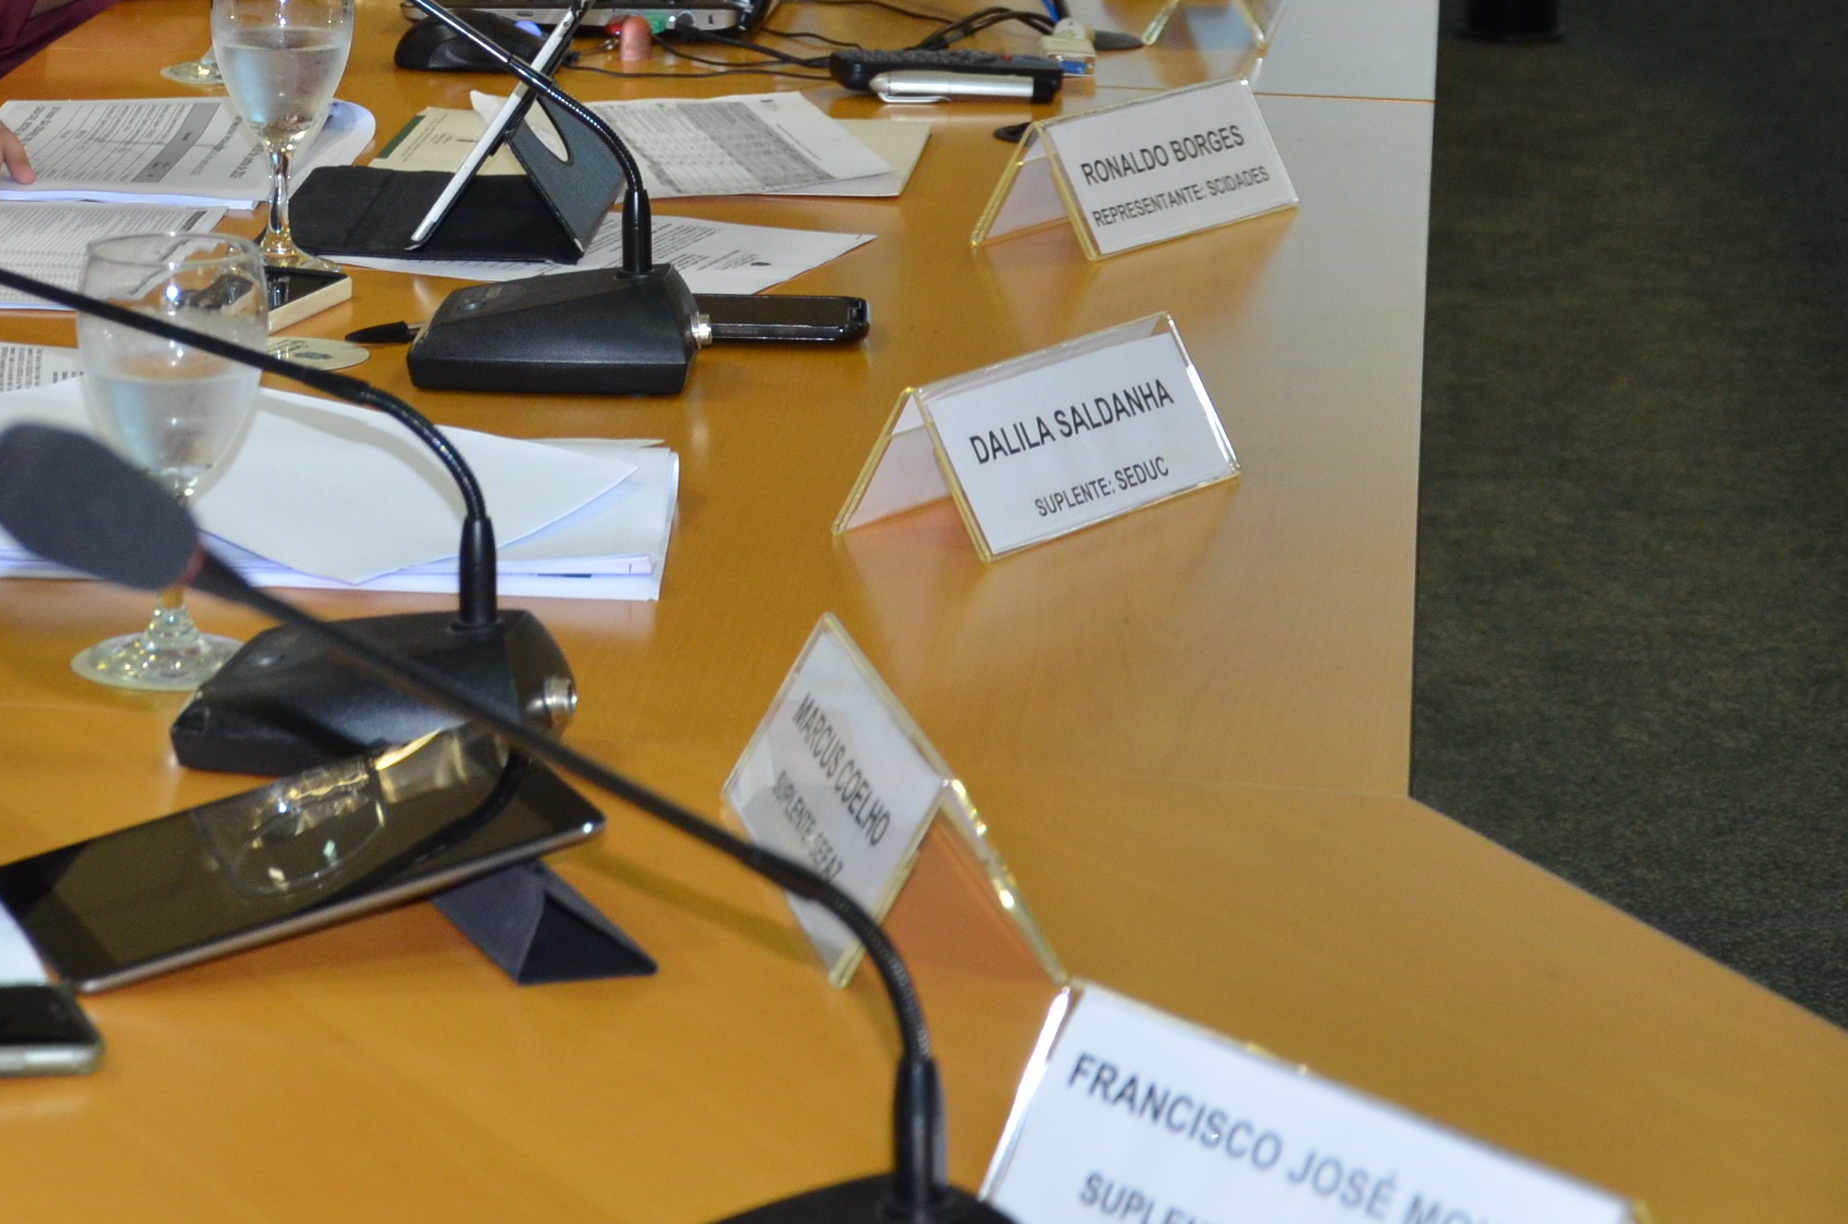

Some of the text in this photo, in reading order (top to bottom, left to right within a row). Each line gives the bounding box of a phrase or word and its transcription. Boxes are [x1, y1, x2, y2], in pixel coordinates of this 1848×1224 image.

[1081, 124, 1244, 186] RONALDO BORGES
[1092, 165, 1270, 227] REPRESENTANTE: SCIDADES
[970, 379, 1174, 464] DALILA SALDANHA
[1035, 456, 1170, 517] SUPLENTE: SEDUC
[773, 770, 817, 843] SUPLENTE
[792, 693, 891, 847] MARCUS COELHO
[1068, 1053, 1399, 1218] FRANCISCO JOSÉ
